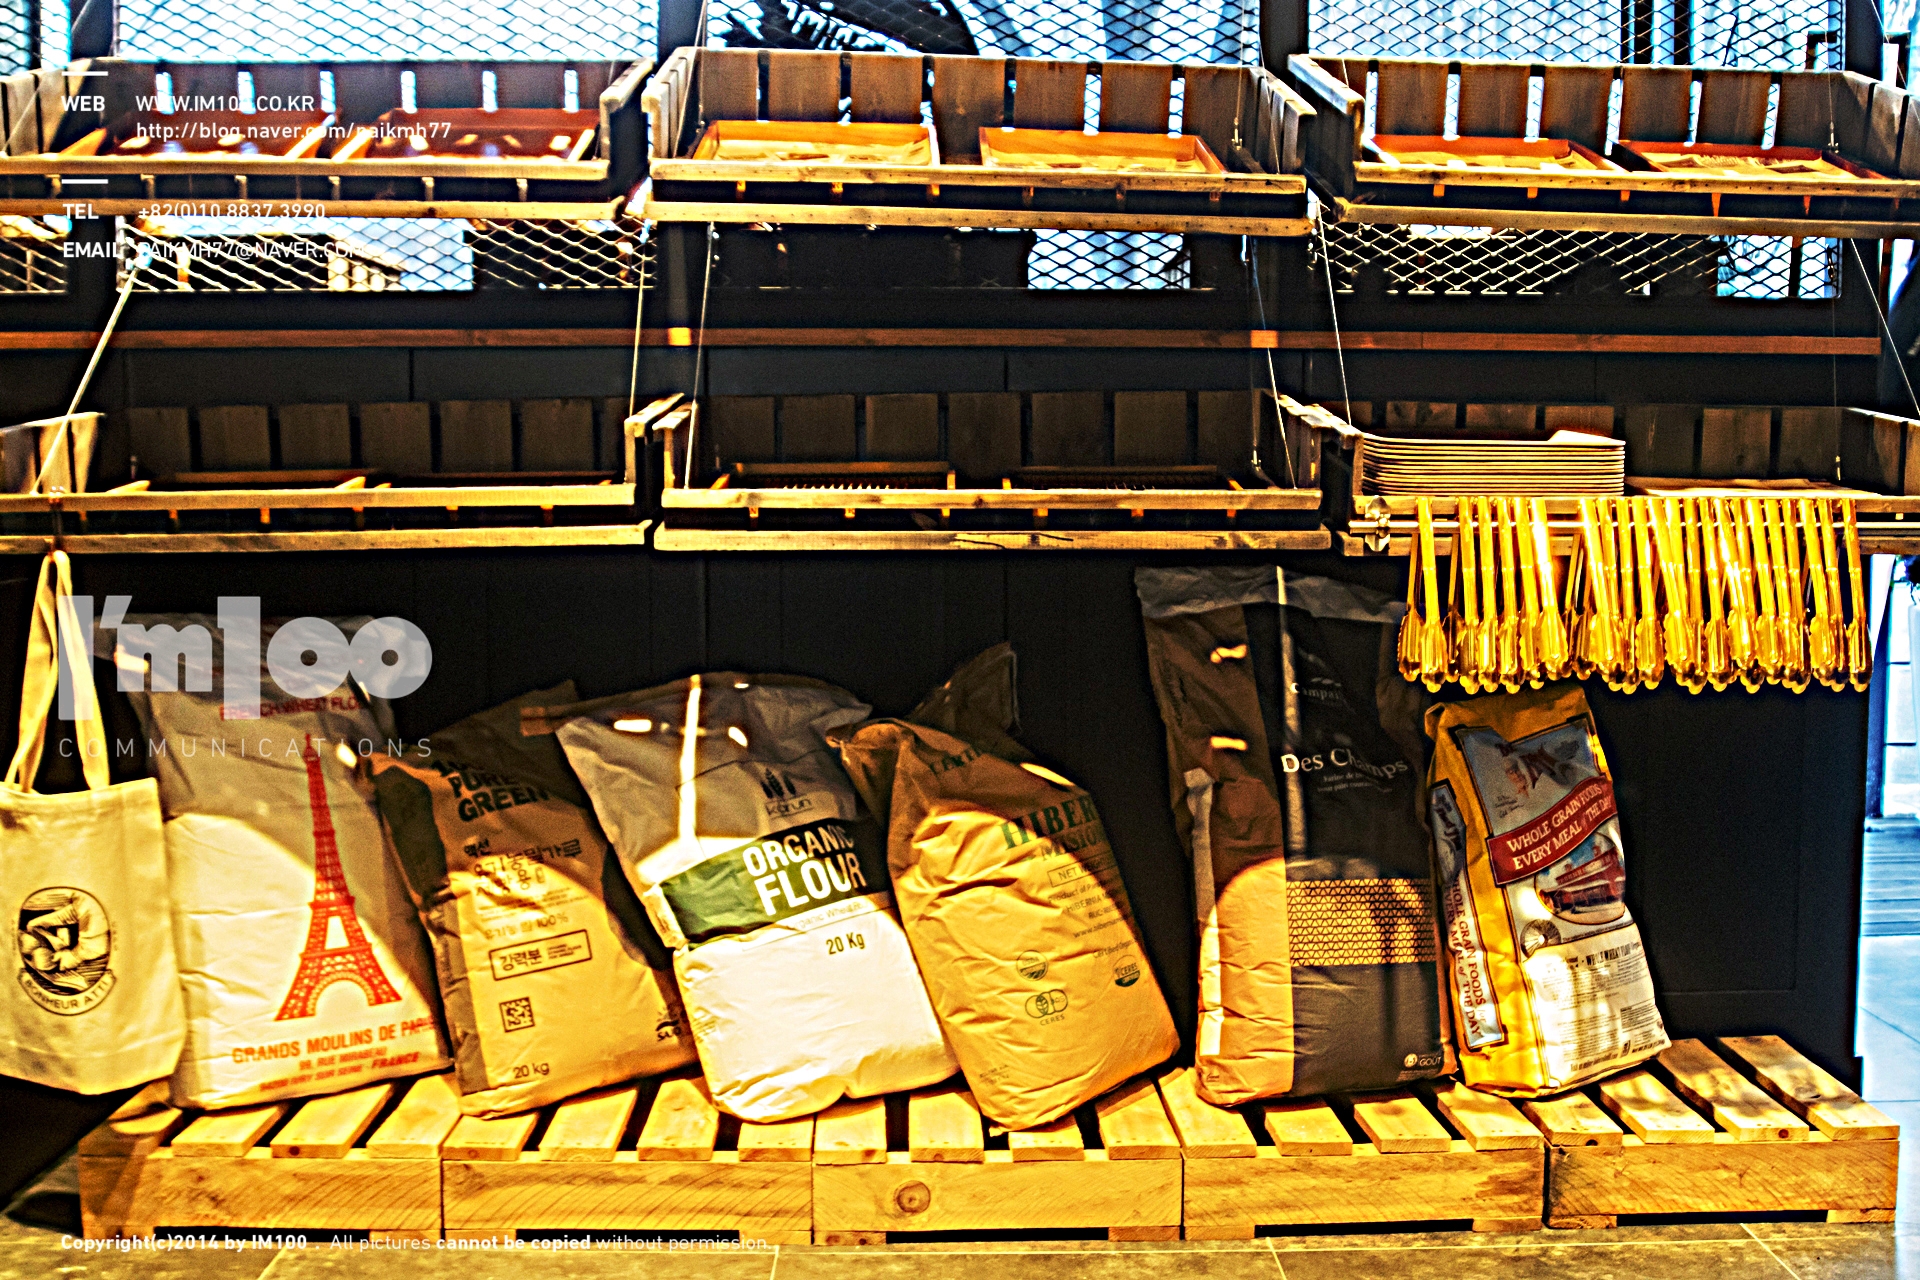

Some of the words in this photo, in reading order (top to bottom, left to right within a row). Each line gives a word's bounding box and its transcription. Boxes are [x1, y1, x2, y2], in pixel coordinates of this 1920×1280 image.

[1281, 753, 1324, 773] Des
[1330, 748, 1409, 780] Champs
[458, 786, 549, 822] GREEN
[1506, 820, 1552, 852] WHOLE
[1551, 797, 1582, 828] GRAIN
[1579, 783, 1602, 805] FOODS
[1512, 841, 1552, 870] EVERY
[1552, 820, 1583, 850] MEAL
[1585, 802, 1600, 822] THE
[1598, 795, 1612, 812] DAY
[742, 824, 855, 876] ORGANIC
[754, 852, 868, 917] FLOUR
[1057, 866, 1078, 881] NET
[826, 936, 845, 955] 20
[846, 931, 866, 950] Kg
[499, 947, 542, 971] 강력분
[1459, 920, 1477, 959] GRAIN
[1468, 962, 1486, 1005] FOODS
[1462, 981, 1473, 1007] THE
[1040, 1014, 1065, 1026] CERES
[1465, 1010, 1481, 1035] DAY
[232, 1041, 300, 1064] GRANDS
[306, 1029, 373, 1054] MOULINS
[378, 1023, 396, 1041] DE
[371, 1052, 420, 1069] FRANCE
[513, 1066, 530, 1079] 20
[532, 1062, 550, 1077] kg
